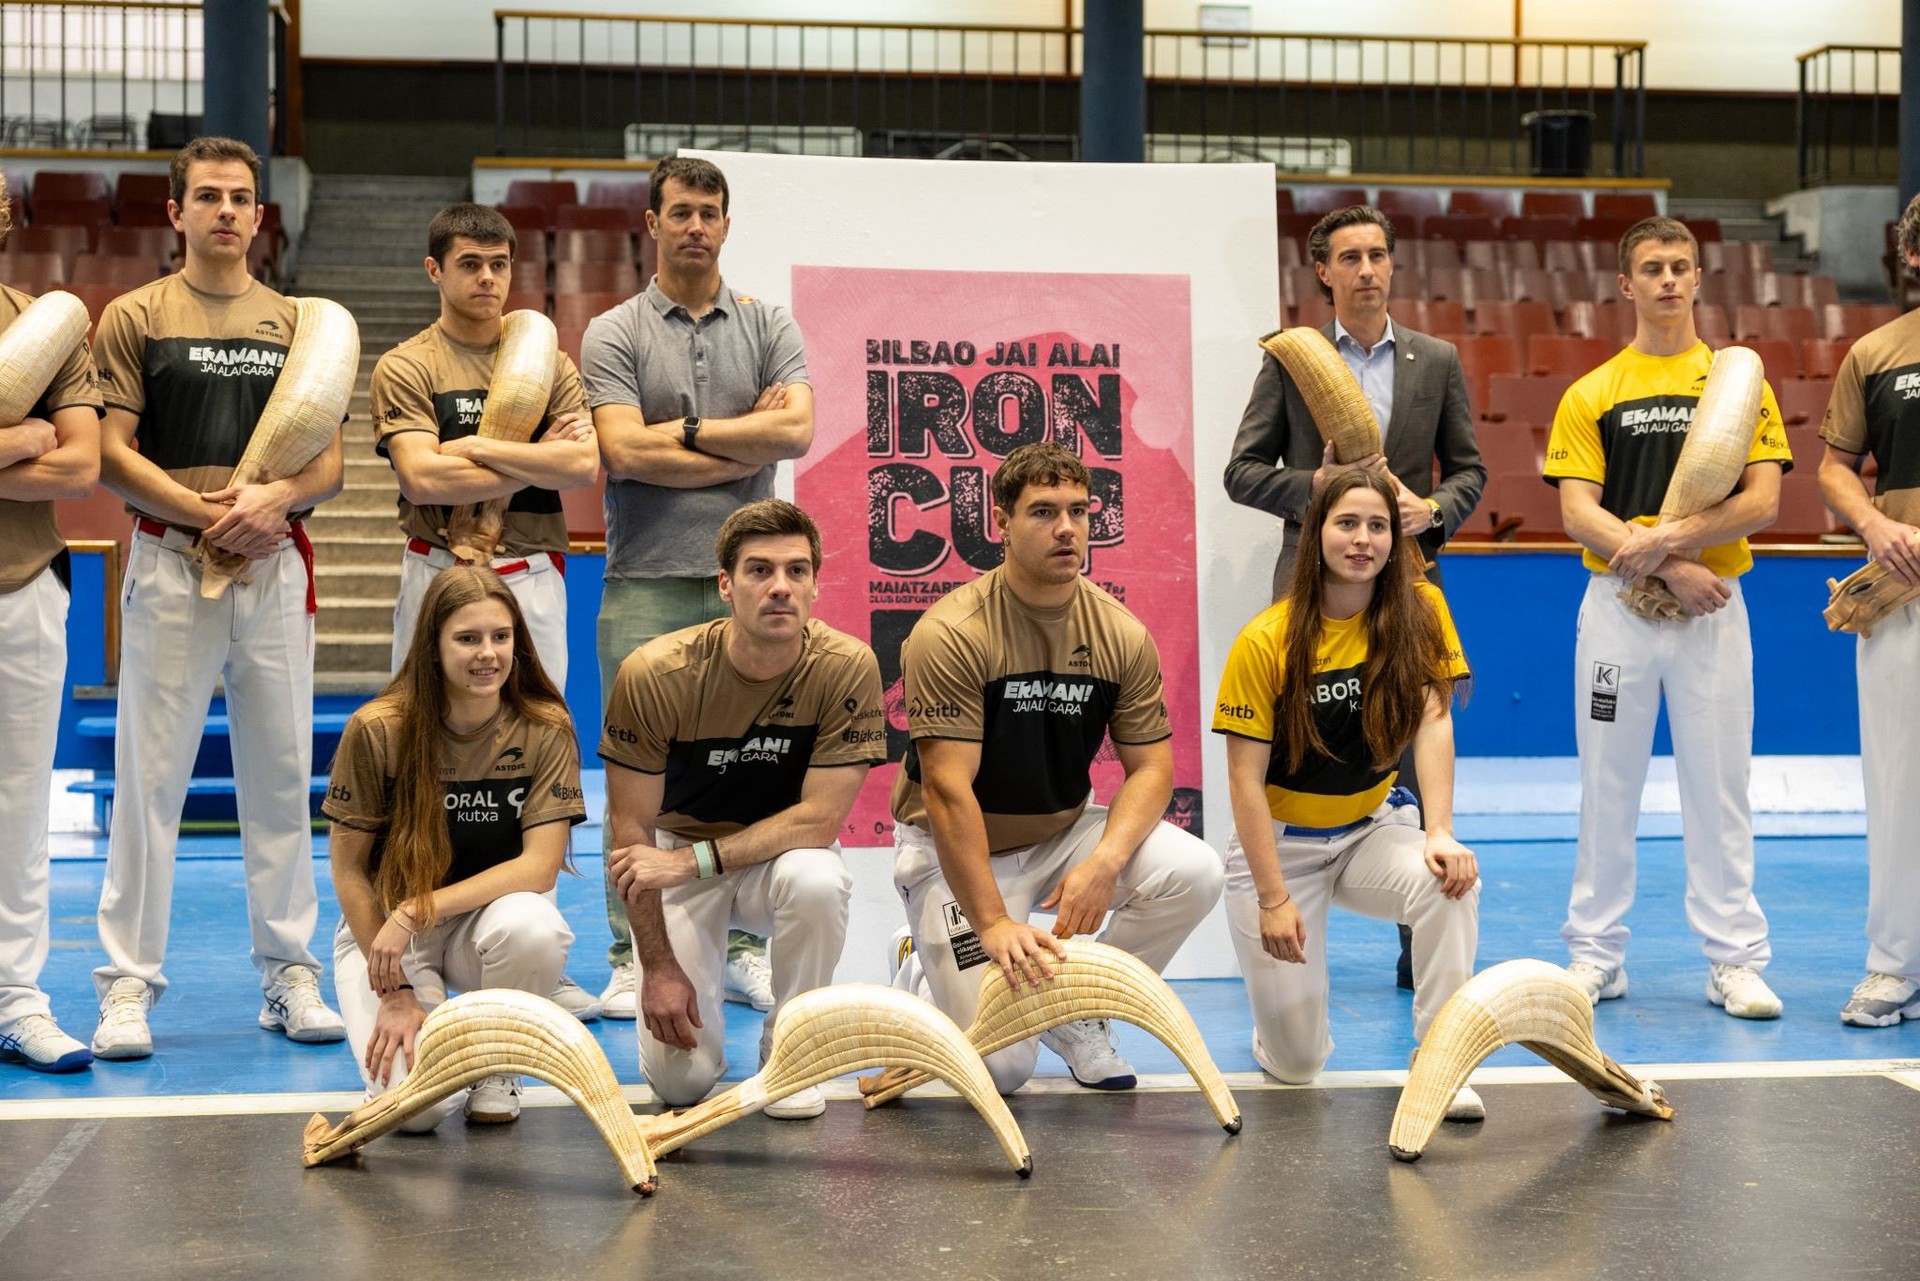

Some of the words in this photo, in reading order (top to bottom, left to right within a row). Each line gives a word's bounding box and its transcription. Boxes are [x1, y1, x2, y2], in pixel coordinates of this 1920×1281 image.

[189, 346, 285, 368] ERAMAN!
[866, 339, 976, 366] BILBAO
[986, 342, 1039, 368] JAI
[1047, 342, 1121, 369] ALAI
[201, 362, 216, 374] JAI
[242, 364, 275, 378] GARA
[866, 370, 1123, 461] IRON
[1621, 406, 1697, 428] ERAMA
[869, 581, 968, 594] MAIATZAR
[1068, 660, 1091, 668] ASTO
[925, 701, 961, 718] eitb
[1048, 701, 1082, 716] GARA
[741, 751, 779, 765] GARA
[328, 781, 351, 802] itb
[443, 790, 499, 810] ORAL
[457, 810, 499, 822] kutxa
